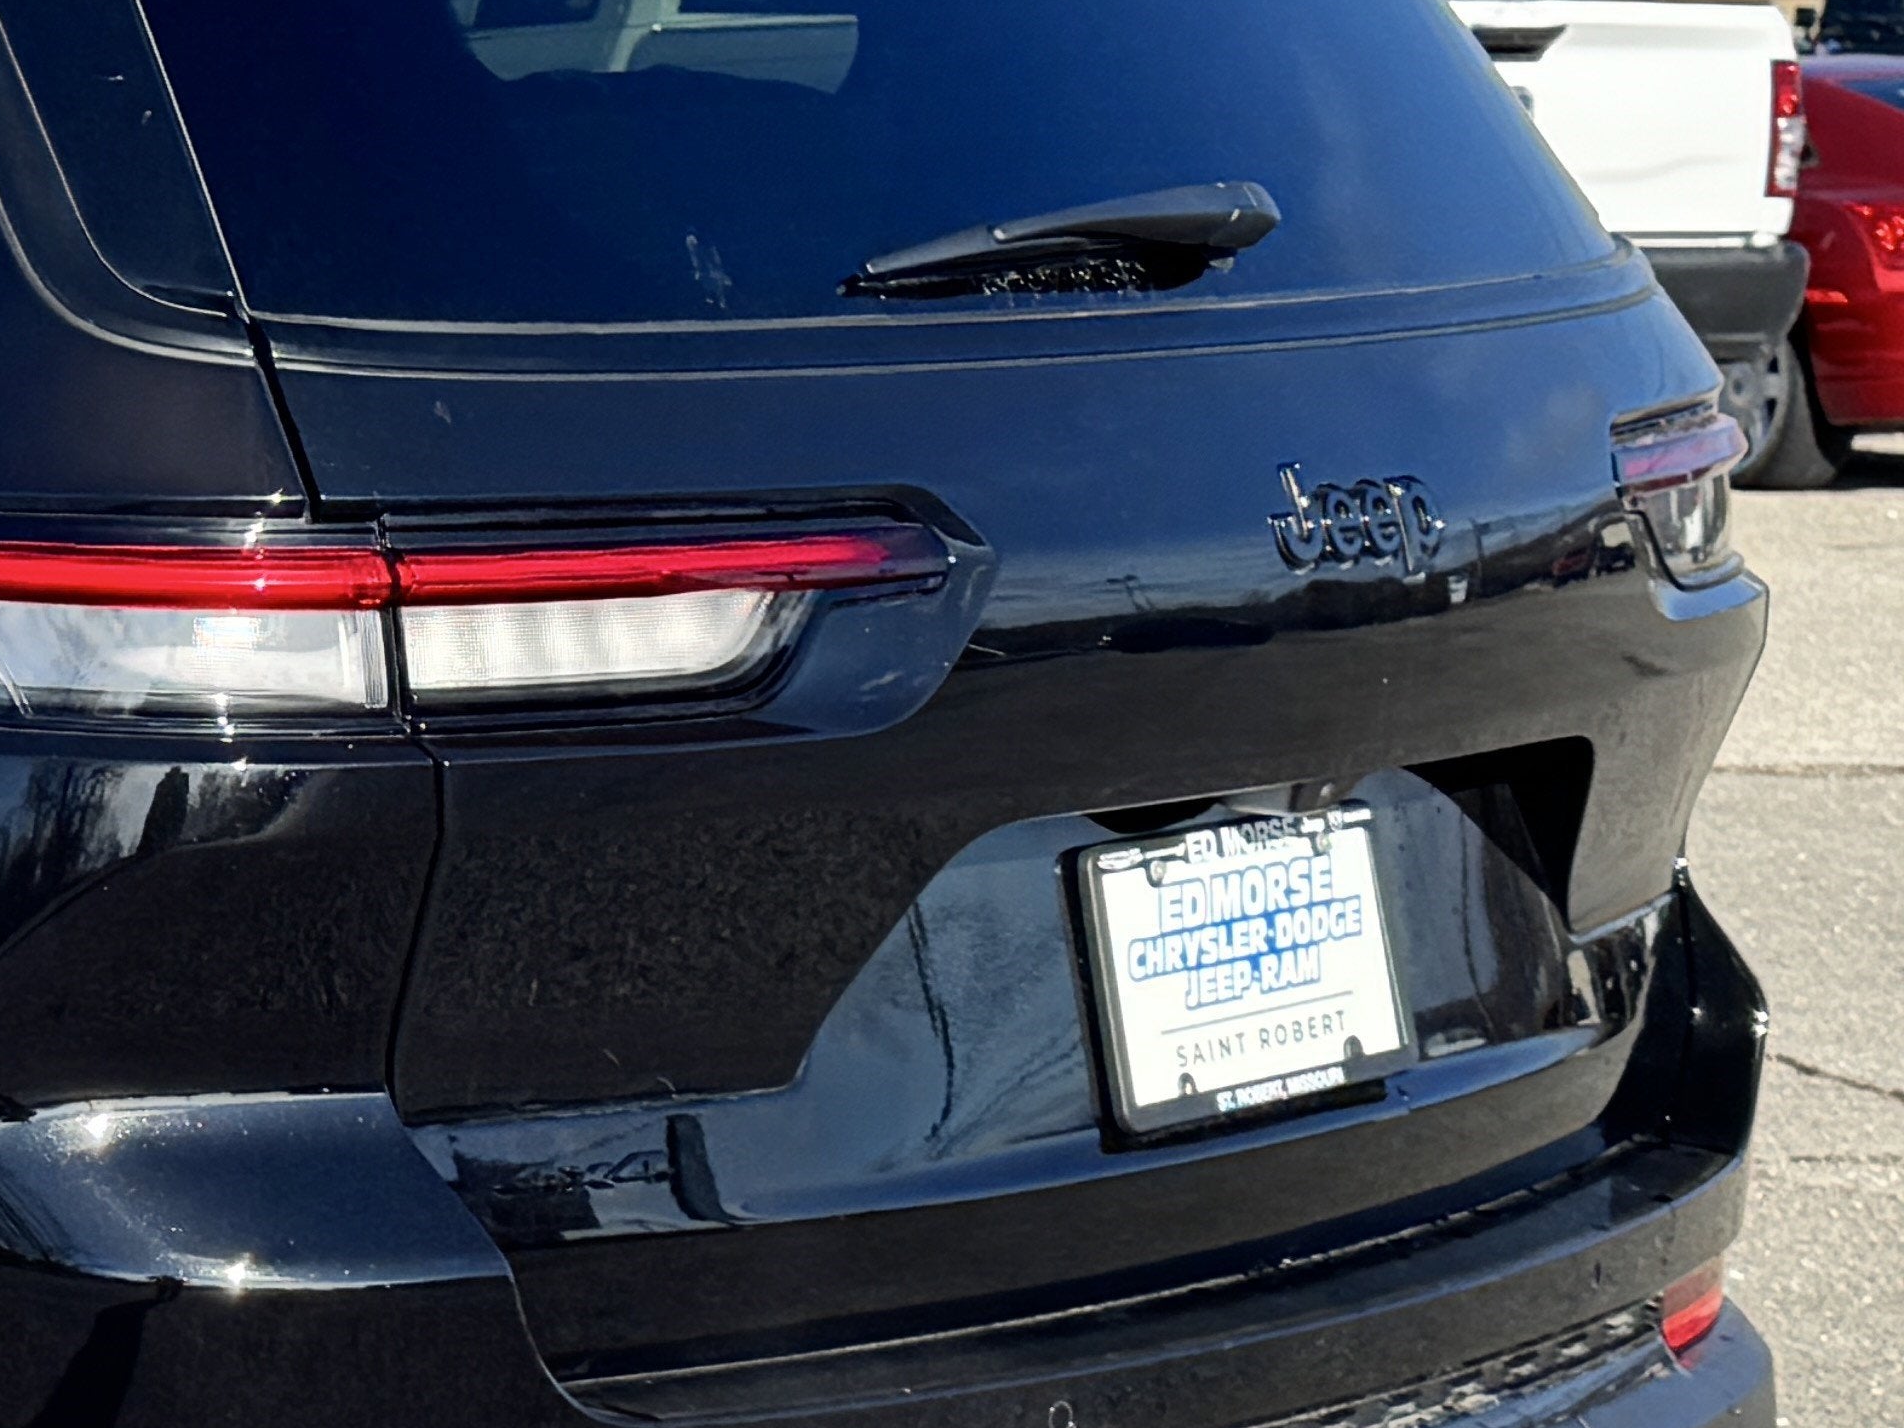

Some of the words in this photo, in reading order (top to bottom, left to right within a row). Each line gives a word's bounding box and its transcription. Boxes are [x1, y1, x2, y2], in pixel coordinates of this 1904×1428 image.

[1266, 460, 1448, 583] Jeep
[1159, 877, 1207, 934] ED
[1209, 855, 1334, 924] MORSE
[1175, 1032, 1246, 1068] SAINT
[1259, 1010, 1348, 1050] ROBERT
